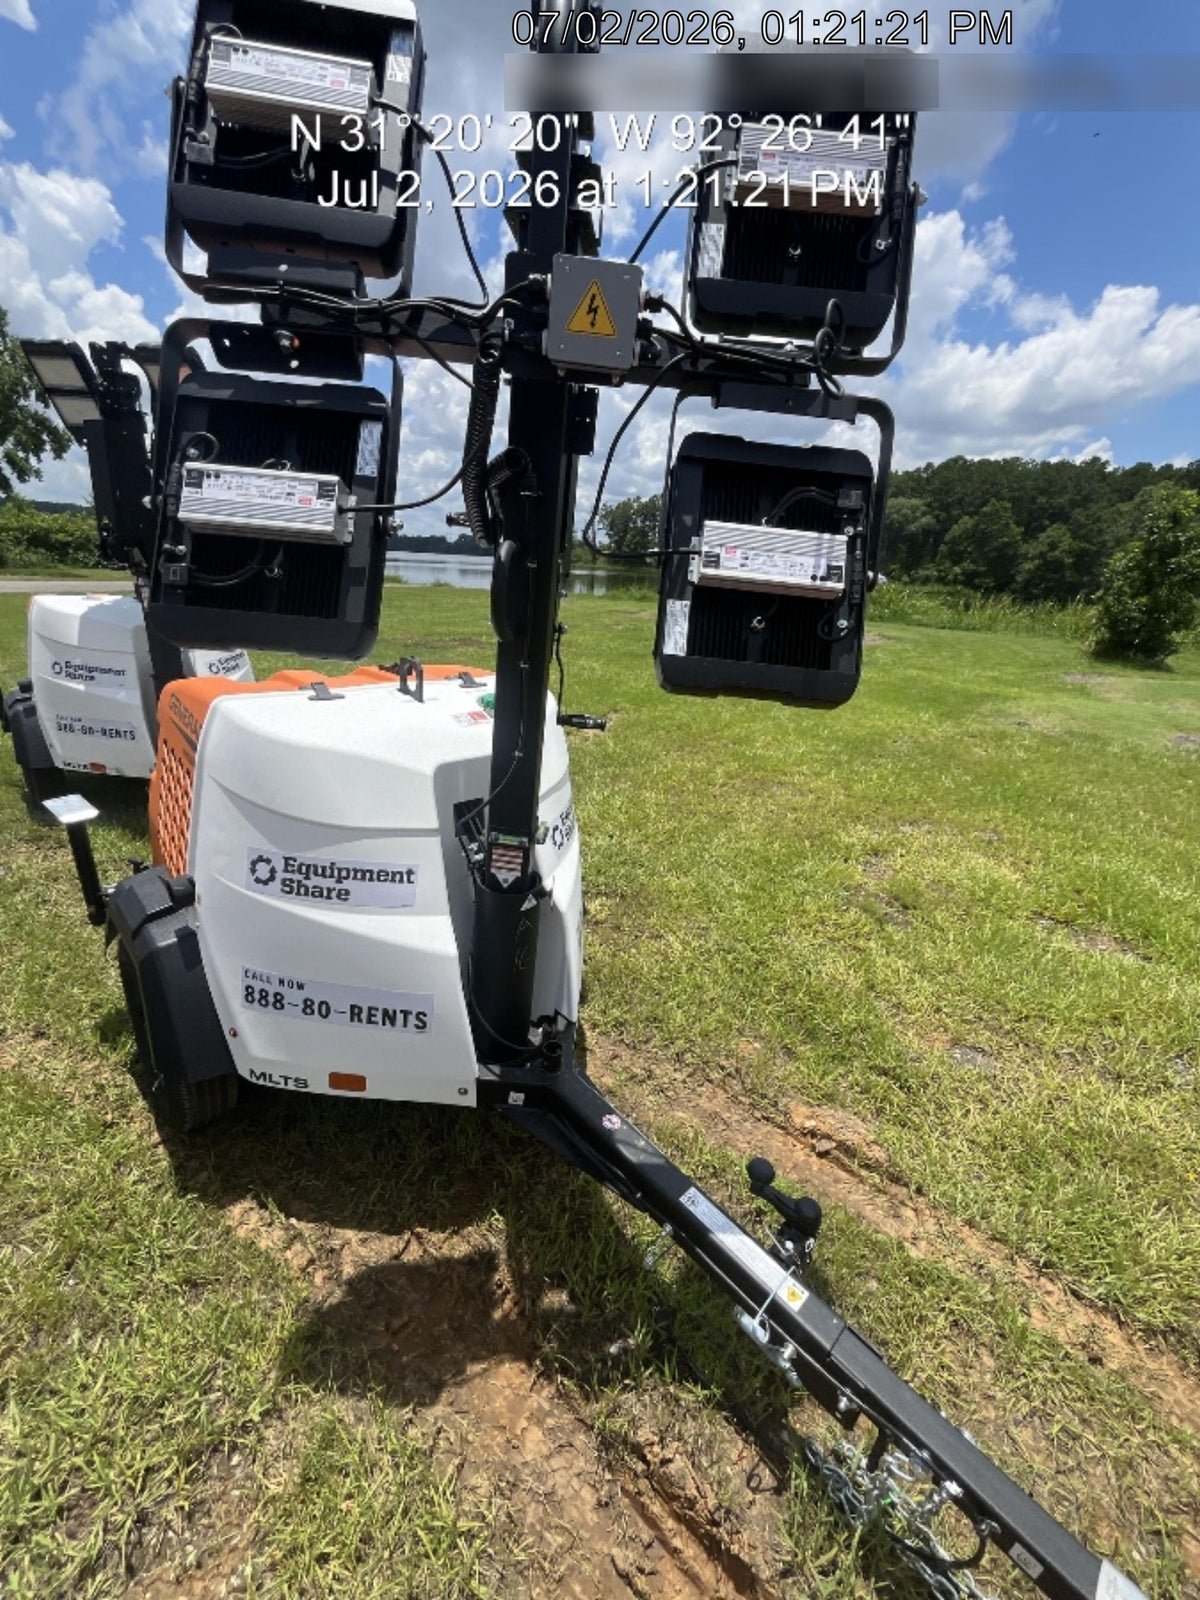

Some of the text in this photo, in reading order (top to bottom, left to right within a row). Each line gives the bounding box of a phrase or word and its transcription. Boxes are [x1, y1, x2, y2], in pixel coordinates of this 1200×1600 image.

[282, 856, 415, 884] Equipment
[280, 877, 351, 902] Share
[244, 968, 306, 992] CALL NOW
[244, 984, 428, 1031] 888-80-RENTS
[249, 1068, 310, 1090] MLTS
